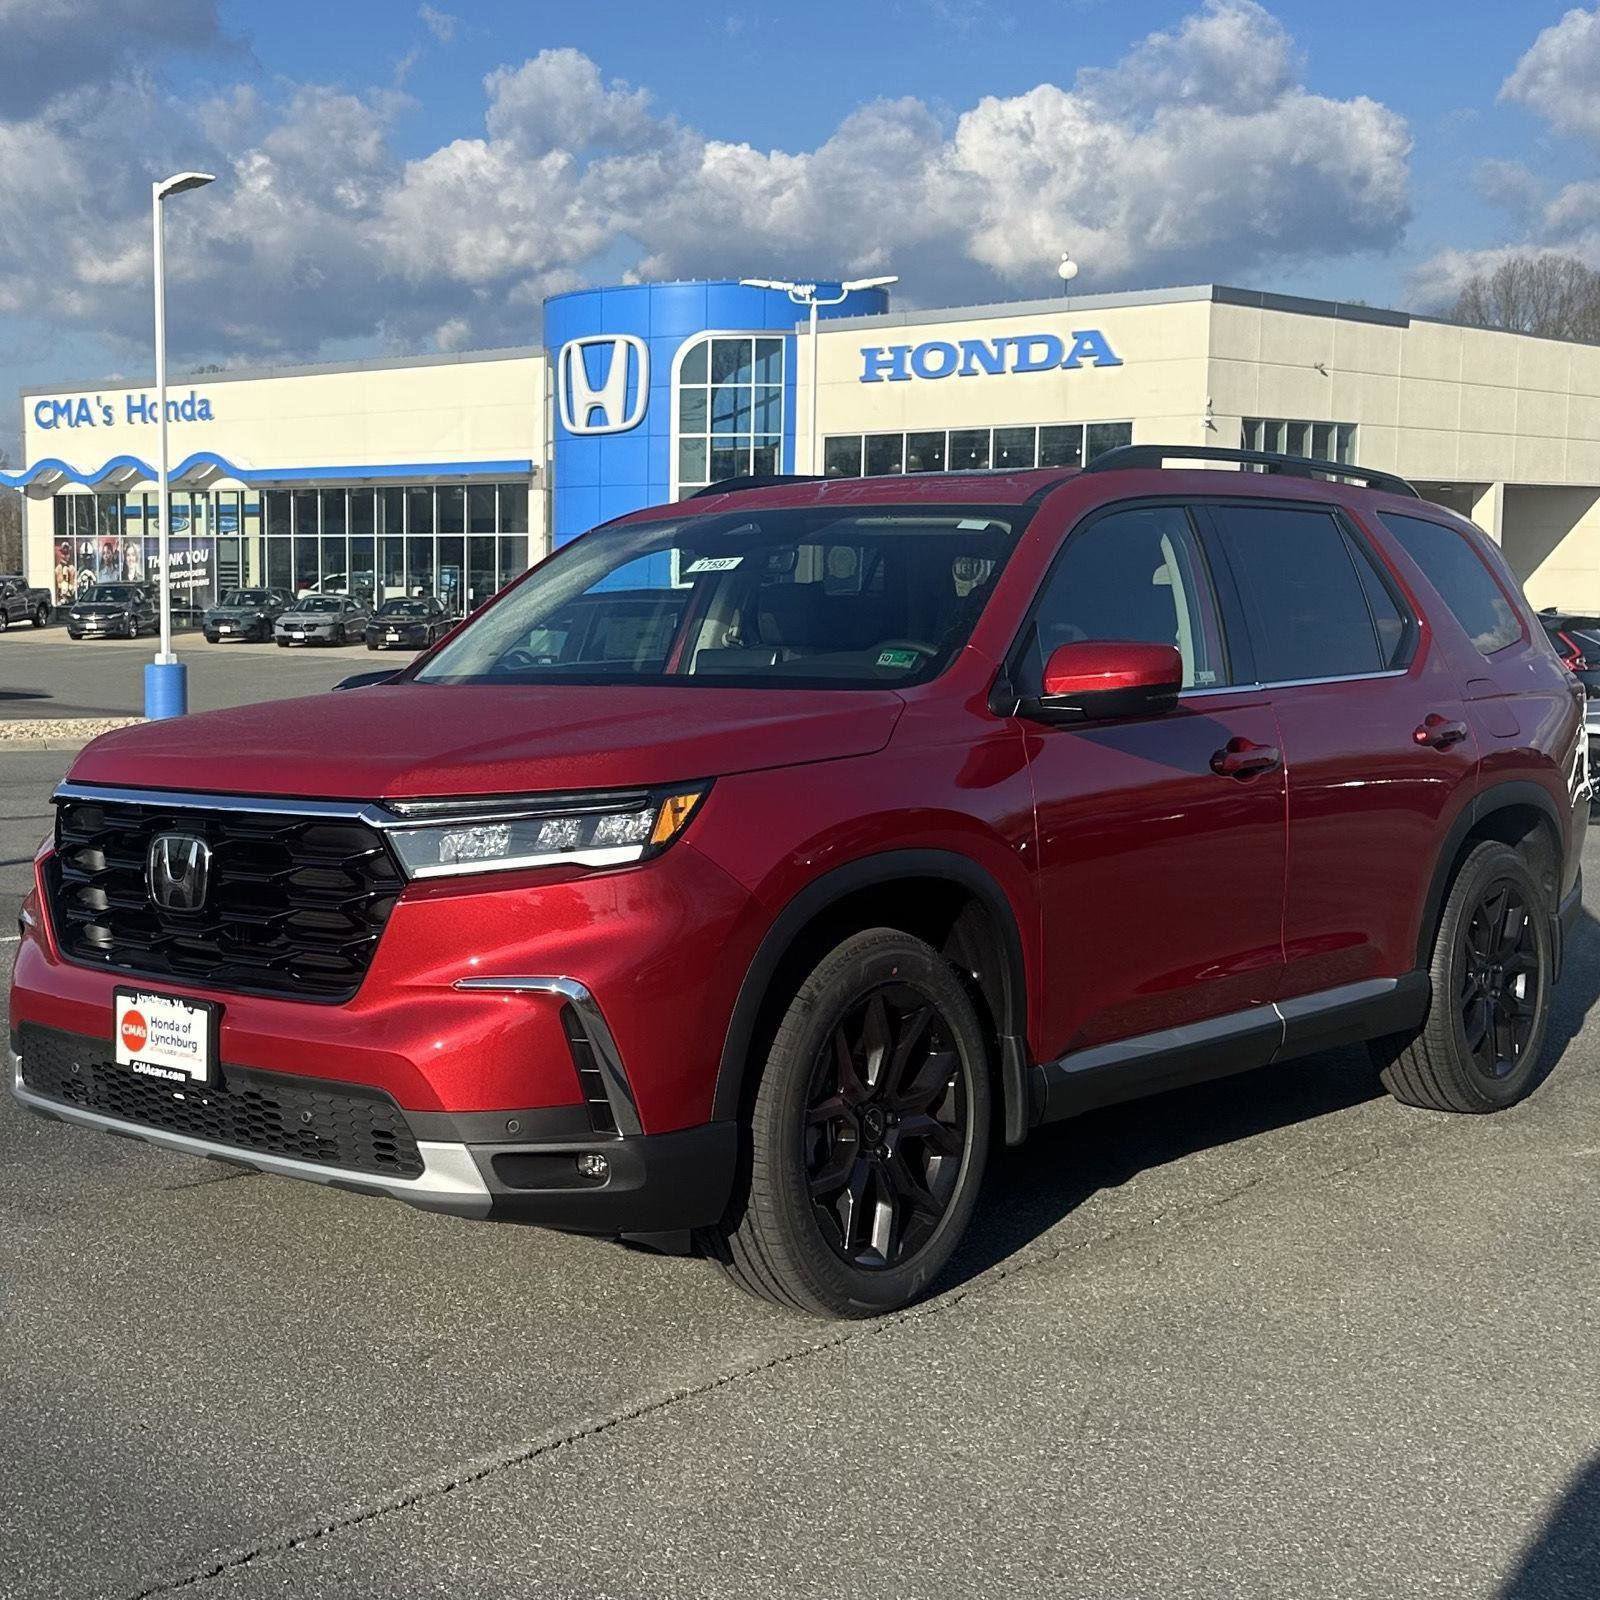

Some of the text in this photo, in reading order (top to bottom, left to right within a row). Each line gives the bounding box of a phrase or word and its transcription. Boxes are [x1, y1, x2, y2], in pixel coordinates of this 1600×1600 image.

[859, 329, 1123, 383] HONDA
[34, 390, 215, 430] CMA's Honda
[147, 548, 209, 569] THNK YOU
[697, 559, 734, 570] 17597
[150, 1016, 192, 1034] Honda of
[150, 1030, 198, 1053] Lynchburg
